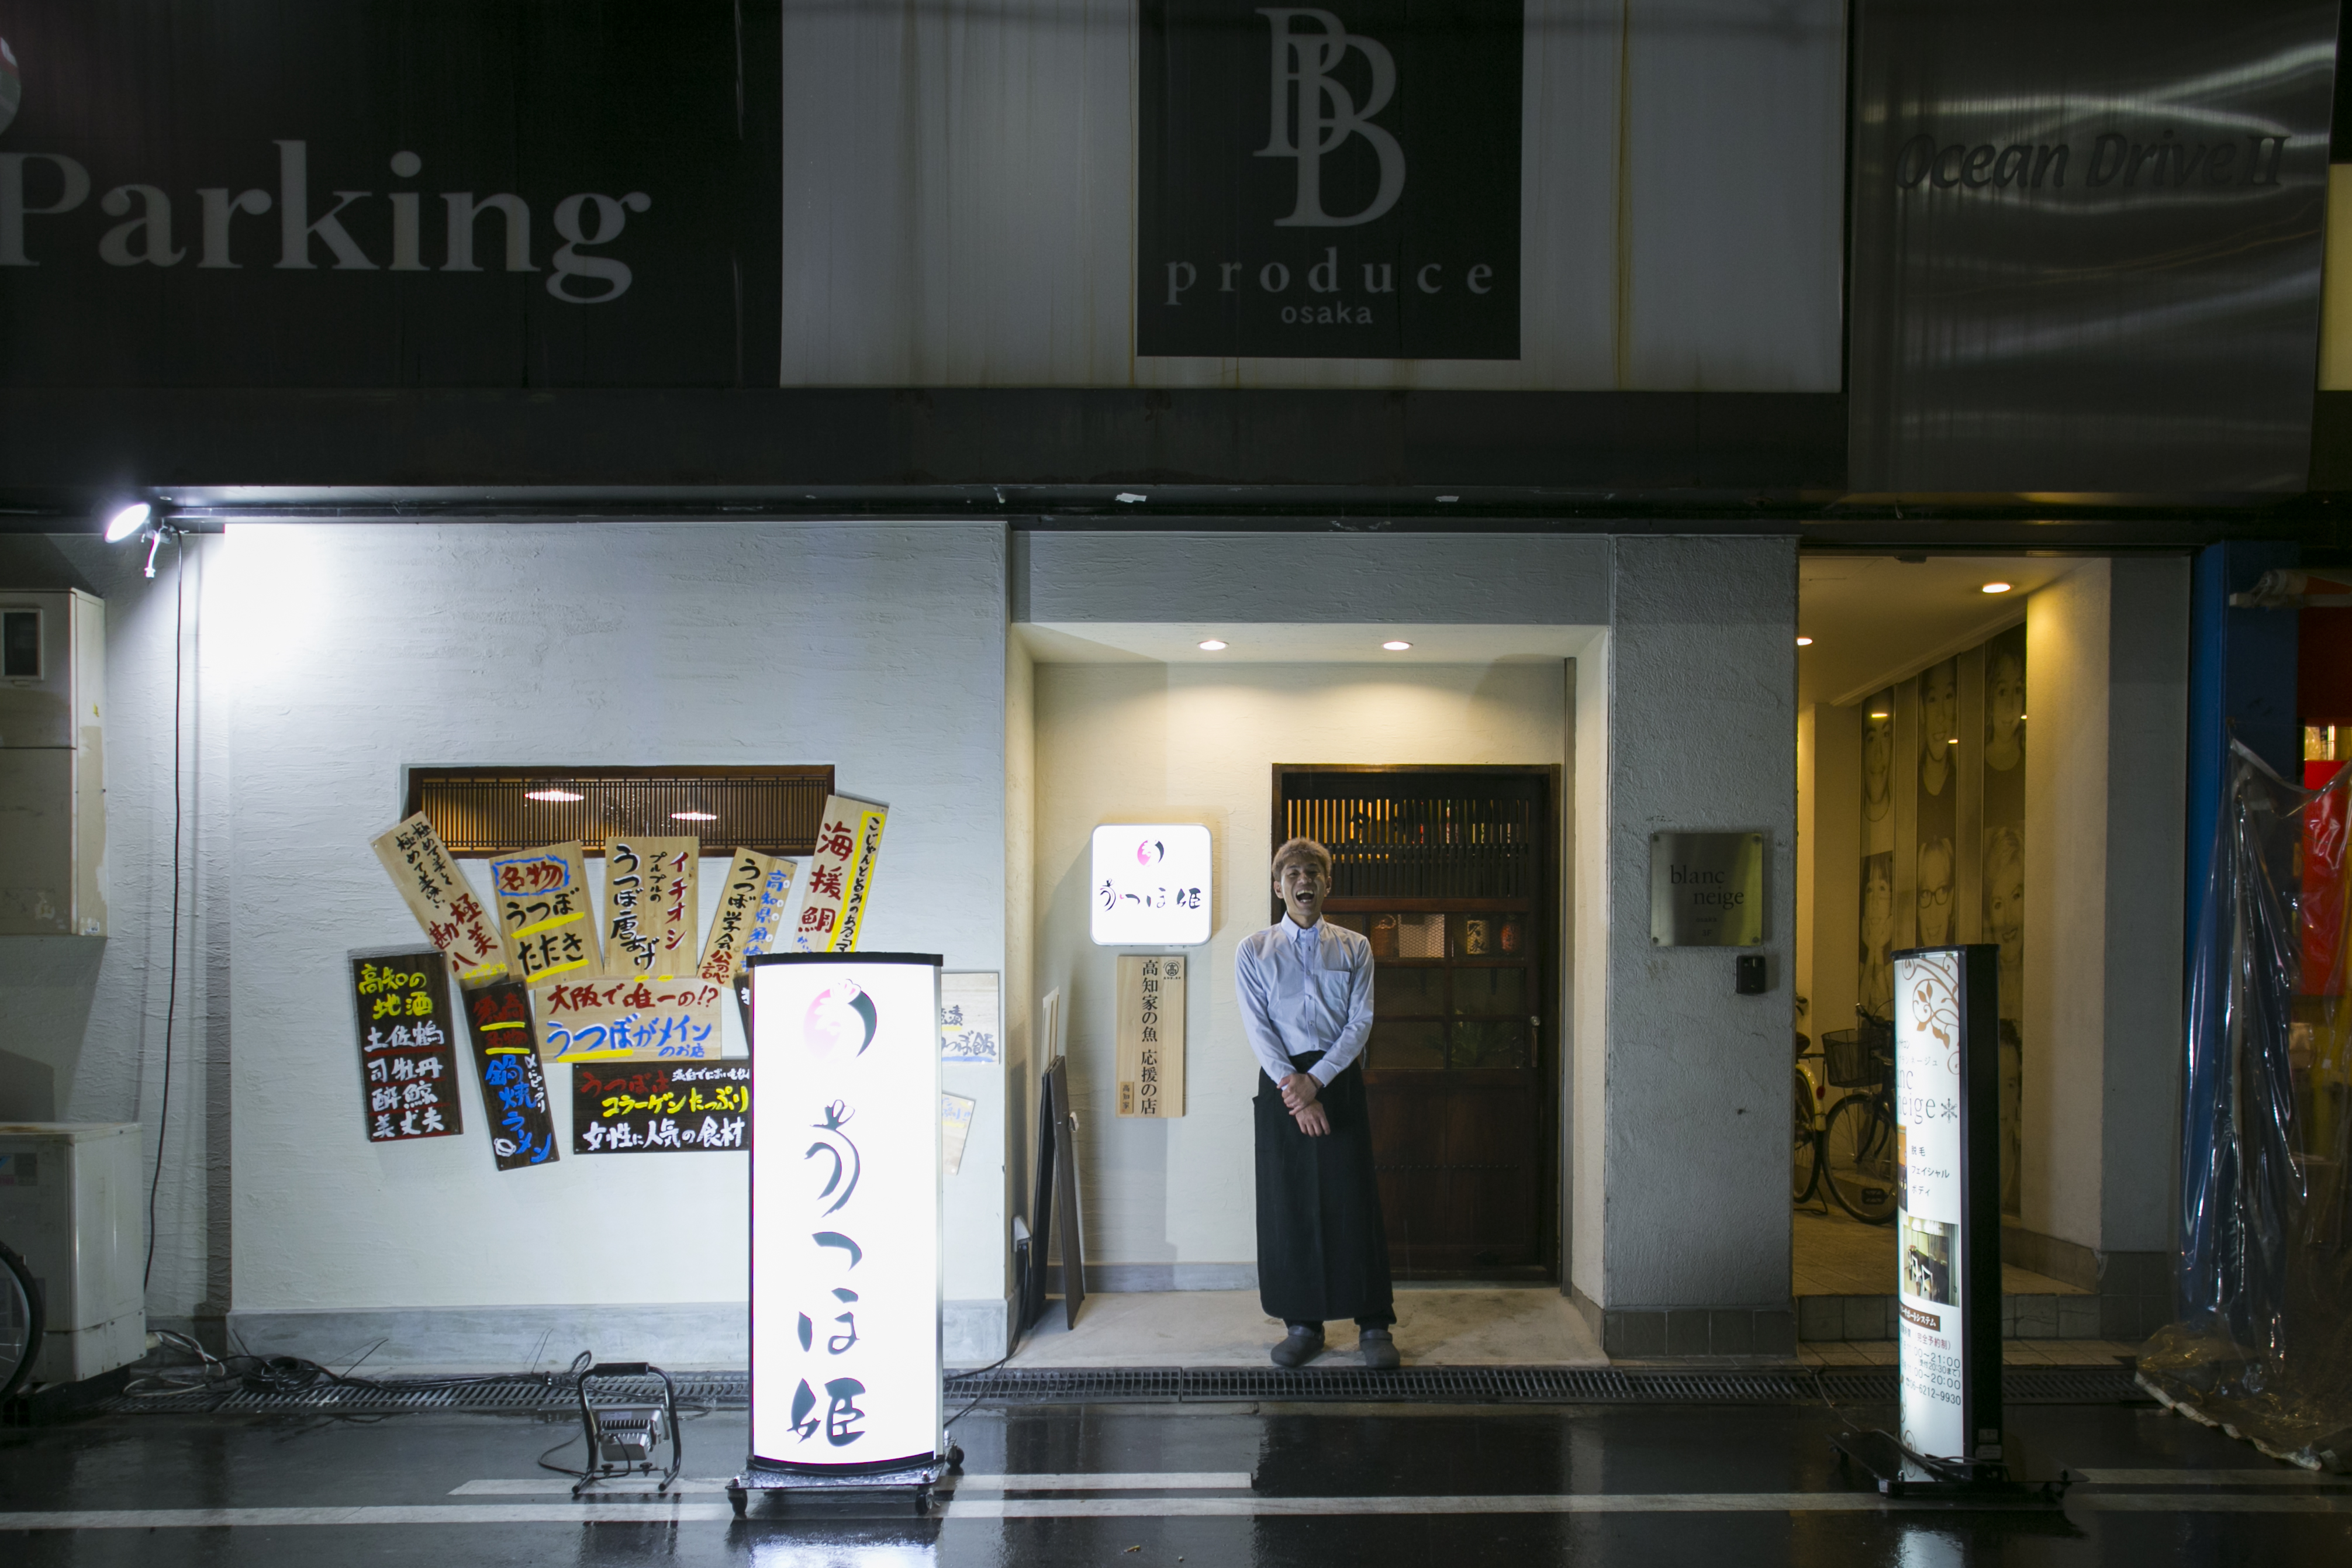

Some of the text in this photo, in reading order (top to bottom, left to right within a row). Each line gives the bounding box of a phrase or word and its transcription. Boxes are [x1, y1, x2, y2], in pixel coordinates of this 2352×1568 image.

[1895, 133, 2070, 189] Ocean
[2086, 129, 2236, 188] Drive
[0, 140, 652, 305] Parking
[1164, 247, 1493, 305] produce
[1282, 301, 1373, 324] osaka
[500, 861, 564, 892] 名物
[650, 851, 668, 903] プルプルの
[798, 821, 853, 933] 海援鯛
[1670, 865, 1725, 884] blanc
[506, 887, 580, 928] うつぼ
[610, 844, 660, 970] うつぼ唐あげ
[665, 852, 689, 951] イチオシ
[1694, 886, 1744, 910] neige
[518, 932, 583, 976] たたき
[358, 963, 427, 995] 高知の
[372, 991, 433, 1020] 地酒
[473, 992, 525, 1025] 須崎
[364, 1020, 445, 1052] 土佐鶴
[485, 1029, 528, 1048] 名物
[546, 1013, 713, 1058] うつぼがメイン
[658, 1044, 705, 1058] のお店
[1141, 959, 1159, 1115] 高知家の魚 応援の店
[367, 1057, 444, 1083] 司牡丹
[581, 1070, 669, 1098] うつぼは
[371, 1080, 438, 1112] 酔鯨
[485, 1054, 552, 1163] 鍋焼ラーメン
[602, 1086, 750, 1117] コラーゲンたっぷり
[372, 1107, 445, 1138] 美丈夫
[583, 1115, 745, 1151] 女性に人気の食材
[1911, 1145, 1926, 1157] 脱毛
[1911, 1166, 1950, 1179] フェイシャル
[1912, 1186, 1930, 1197] ボディ
